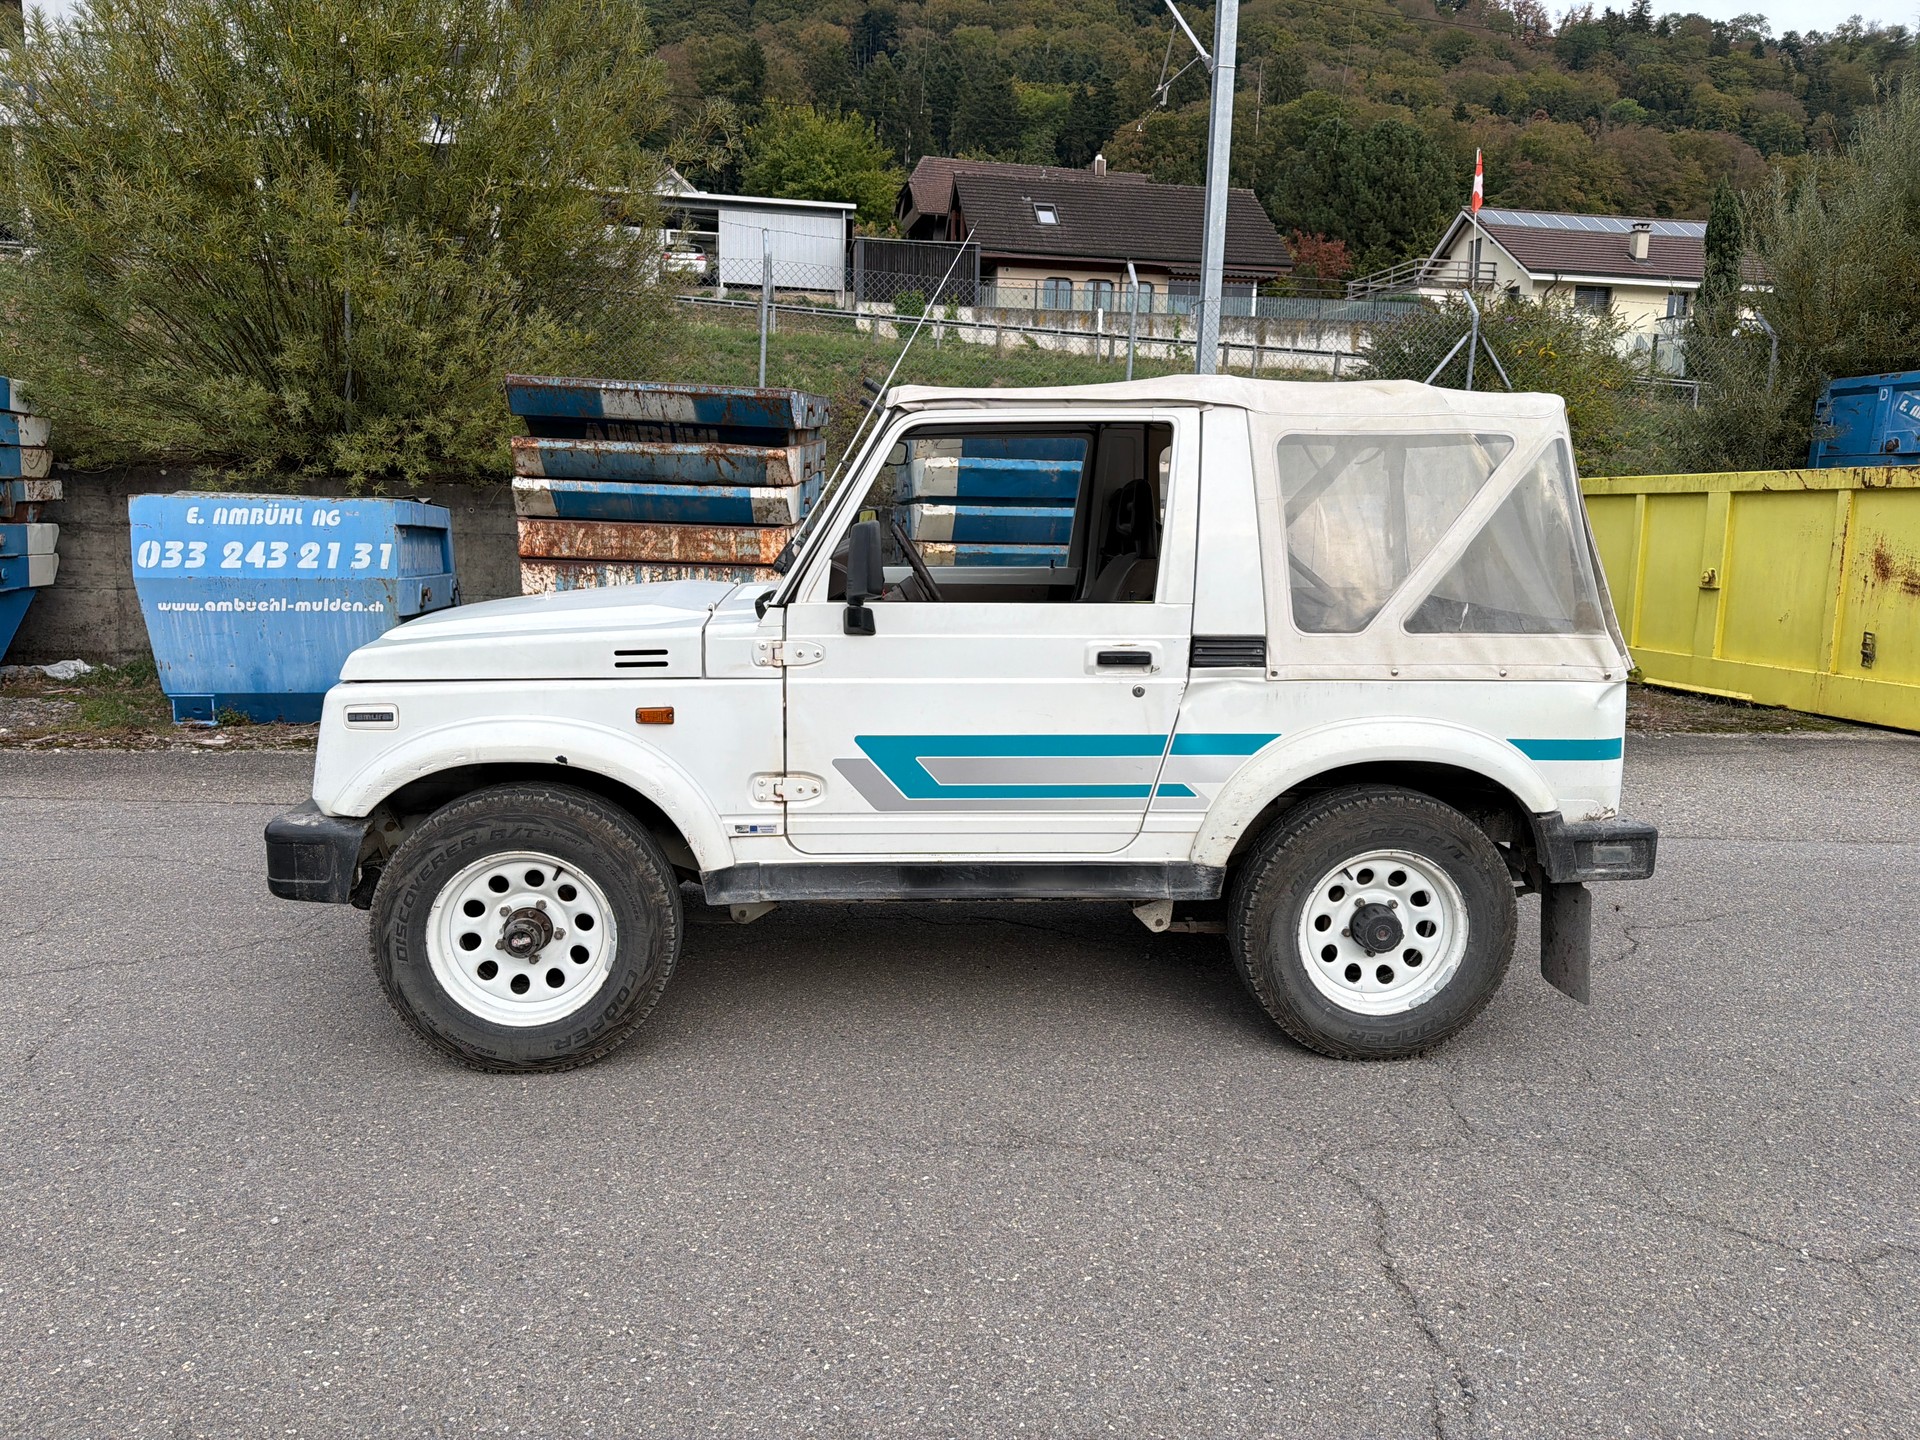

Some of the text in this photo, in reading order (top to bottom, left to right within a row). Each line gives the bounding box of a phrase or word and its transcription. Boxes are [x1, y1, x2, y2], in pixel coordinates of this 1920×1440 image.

[1880, 388, 1889, 401] D
[186, 503, 341, 526] E. AMBÜHL AG
[137, 540, 208, 569] 033
[220, 541, 289, 569] 243
[297, 542, 341, 569] 21
[350, 543, 393, 570] 31
[157, 598, 384, 612] www.ambuehl-mulden.ch
